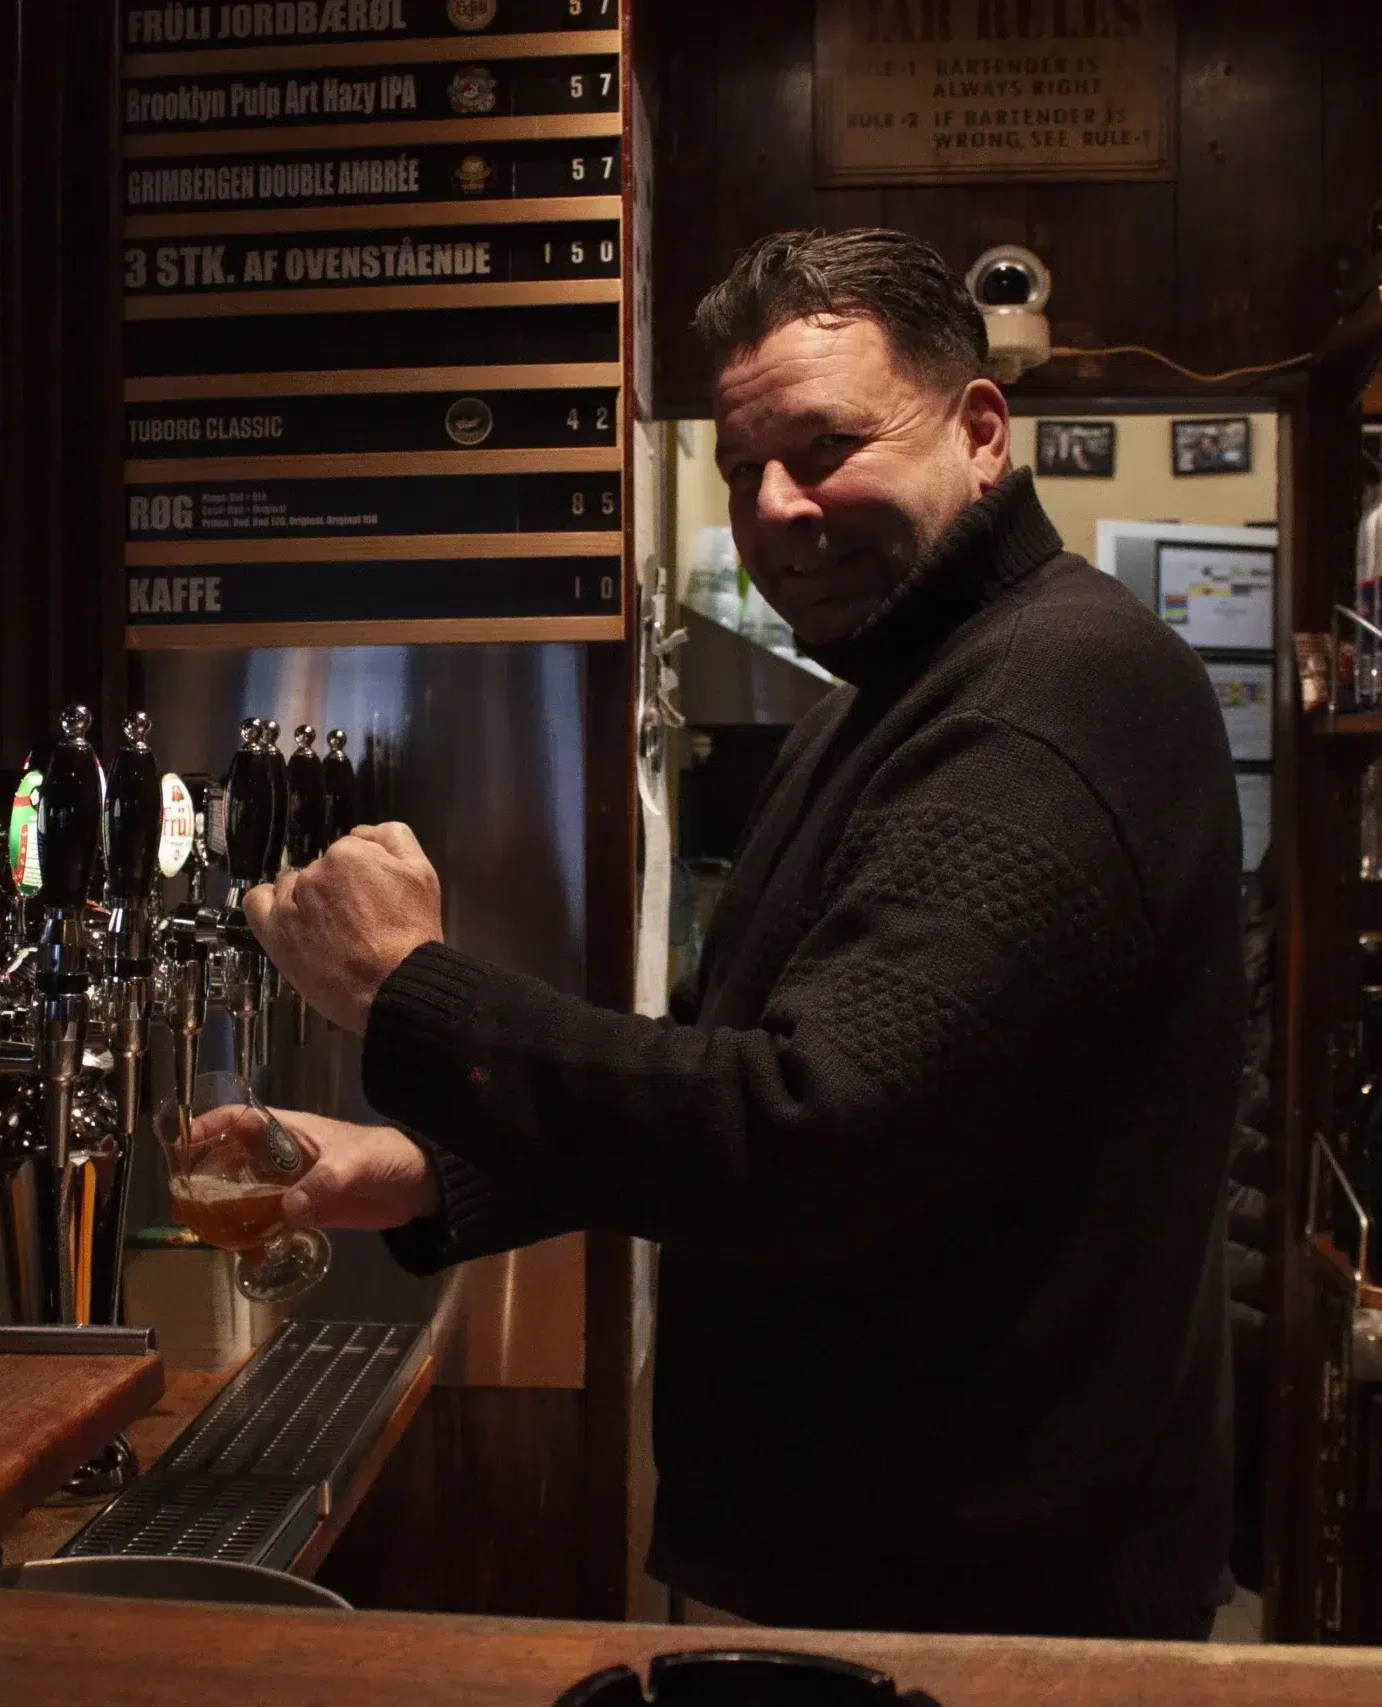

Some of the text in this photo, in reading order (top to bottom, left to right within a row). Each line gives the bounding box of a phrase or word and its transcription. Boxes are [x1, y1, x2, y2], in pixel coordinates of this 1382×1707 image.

[127, 1, 211, 44] FRÜLI
[936, 56, 1068, 77] BARTENDER
[1076, 56, 1100, 74] IS
[126, 73, 417, 123] Brooklyn Pulp Art Hazy IPA
[933, 77, 1103, 98] ALWAYS RIGHT
[935, 109, 955, 126] IF
[964, 107, 1096, 126] BARTENDER
[1104, 106, 1127, 124] IS
[1031, 129, 1071, 148] SEE
[127, 154, 420, 204] GRIMBERGEN DOUBLE AMBRÉE
[123, 236, 491, 289] 3 STK. AF OVENSTÅENDE
[128, 414, 284, 442] TUBORG CLASSIC
[128, 495, 194, 531] RØG
[129, 576, 221, 612] KAFFE
